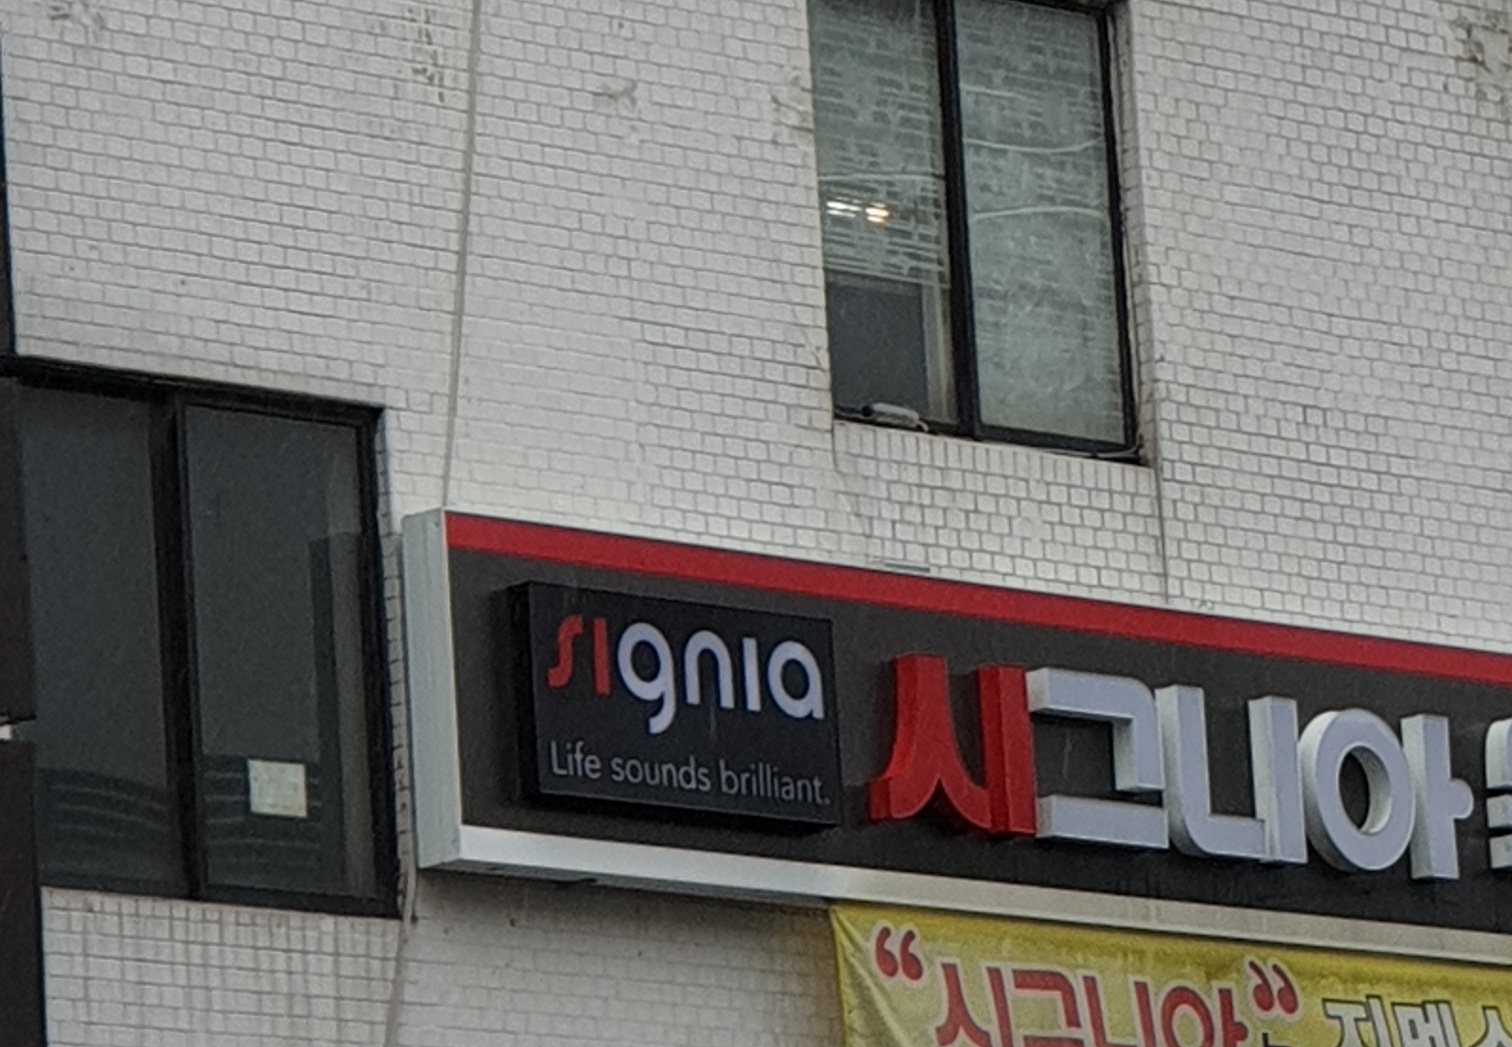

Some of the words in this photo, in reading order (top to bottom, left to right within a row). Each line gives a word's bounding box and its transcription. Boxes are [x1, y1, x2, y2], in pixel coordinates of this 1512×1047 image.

[547, 613, 825, 736] signia
[550, 740, 602, 779] Life
[610, 755, 712, 792] sounds
[718, 758, 831, 805] brilliant.
[868, 651, 1473, 880] 시그니아
